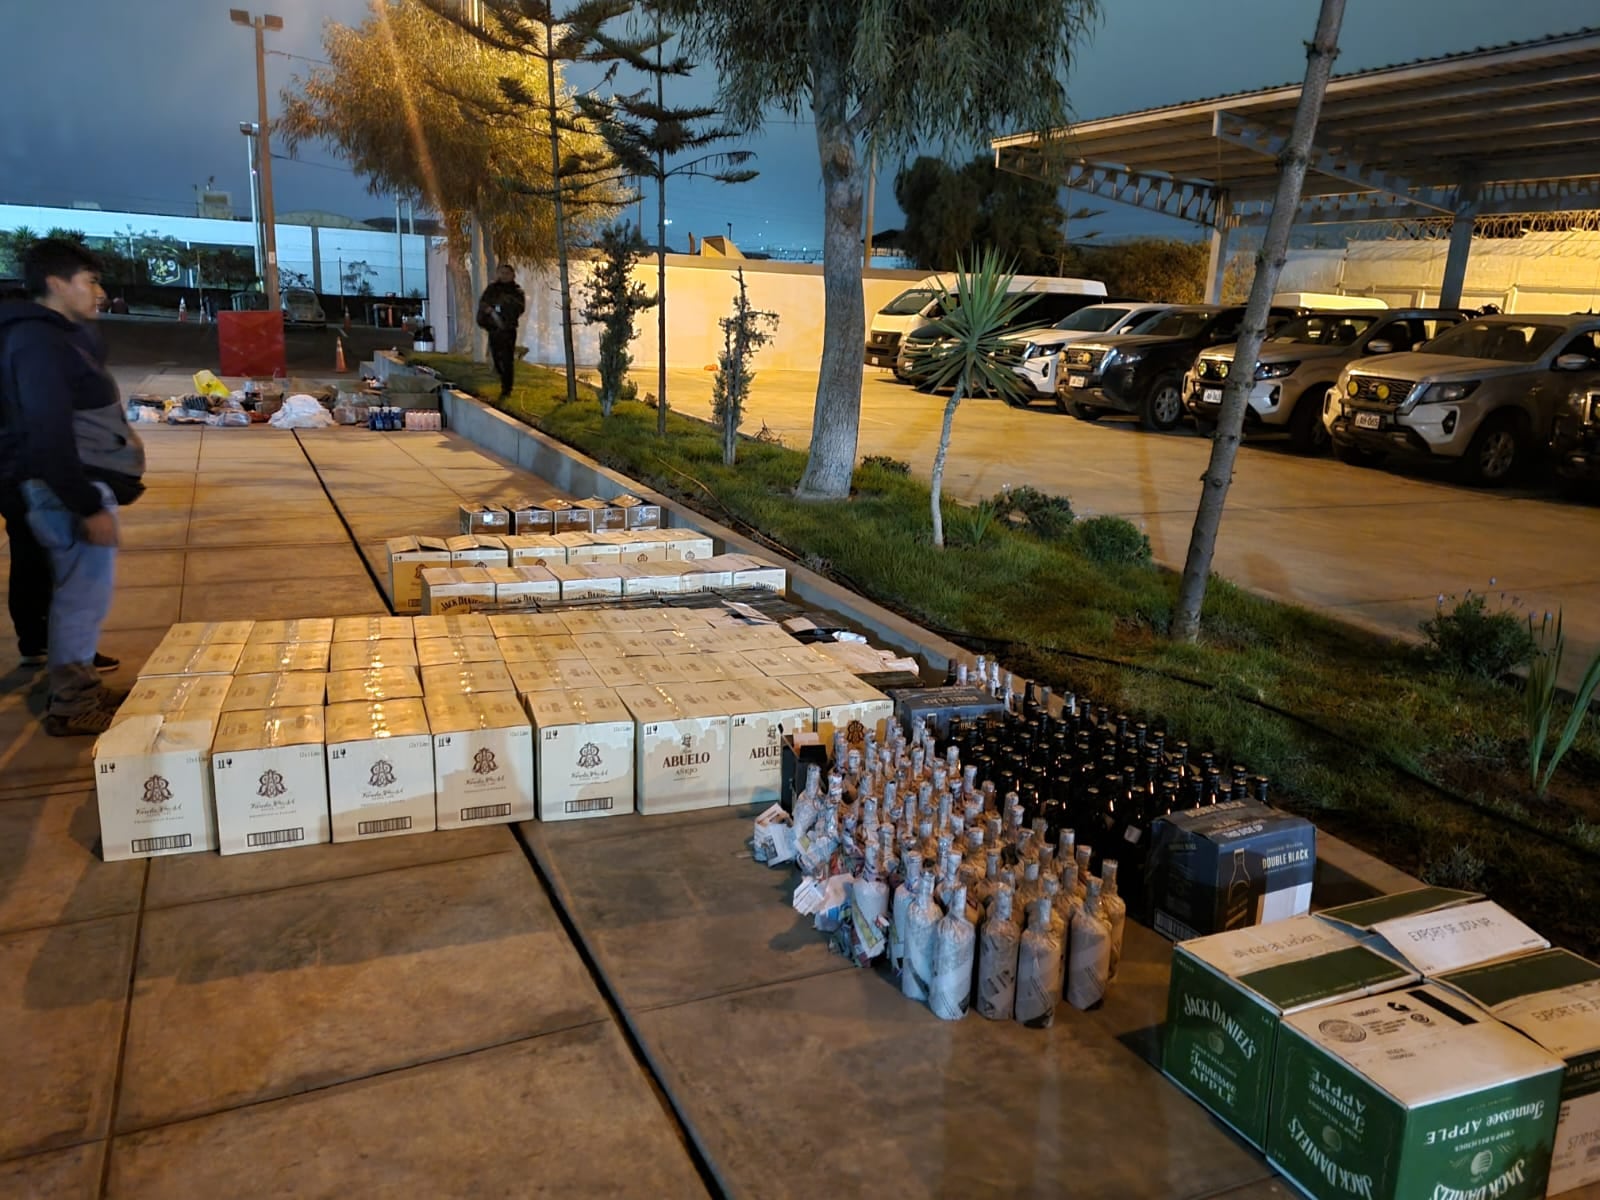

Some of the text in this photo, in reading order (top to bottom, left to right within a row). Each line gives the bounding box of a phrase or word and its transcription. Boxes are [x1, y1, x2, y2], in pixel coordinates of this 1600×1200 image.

[662, 751, 710, 768] ABUELO
[749, 745, 780, 760] ABUE
[1262, 853, 1287, 870] DOUBLE
[1287, 848, 1309, 864] BLACK
[1184, 993, 1257, 1060] JACK DANIEL'S
[1190, 1050, 1237, 1093] Tennessee
[1190, 1069, 1235, 1106] APPLE
[1310, 1066, 1366, 1113] APPLE
[1308, 1080, 1365, 1134] Tennessee
[1486, 1100, 1545, 1129] Tennessee
[1424, 1119, 1482, 1145] APPLE
[1287, 1117, 1373, 1200] JACK DANIEL'S
[1488, 1158, 1526, 1200] JACK
